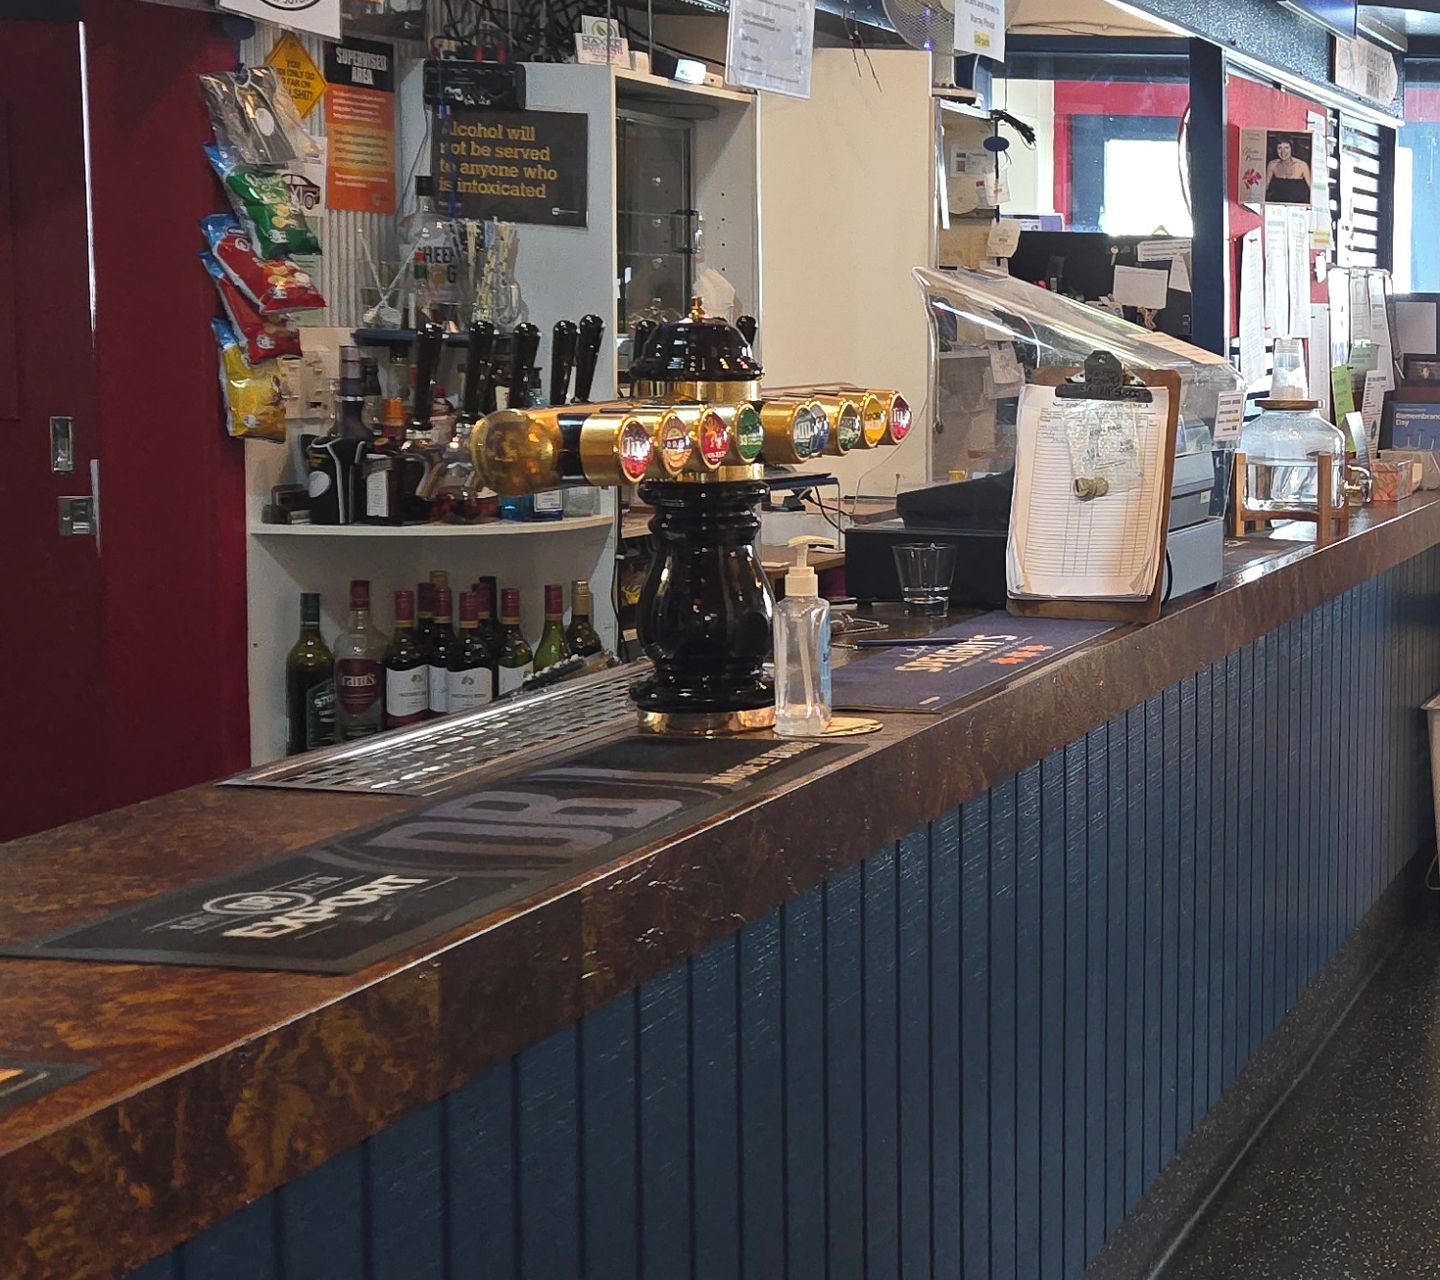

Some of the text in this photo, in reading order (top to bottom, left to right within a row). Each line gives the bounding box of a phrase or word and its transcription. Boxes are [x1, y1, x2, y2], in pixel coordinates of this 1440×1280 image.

[336, 47, 388, 72] SUPERVISED
[352, 68, 374, 85] AREA
[507, 126, 535, 141] will
[470, 140, 490, 157] be
[495, 146, 550, 161] served
[460, 161, 519, 179] anyone
[523, 165, 558, 181] who
[457, 178, 547, 199] intoxicated
[221, 874, 430, 938] EXPORT
[223, 895, 295, 910] DB
